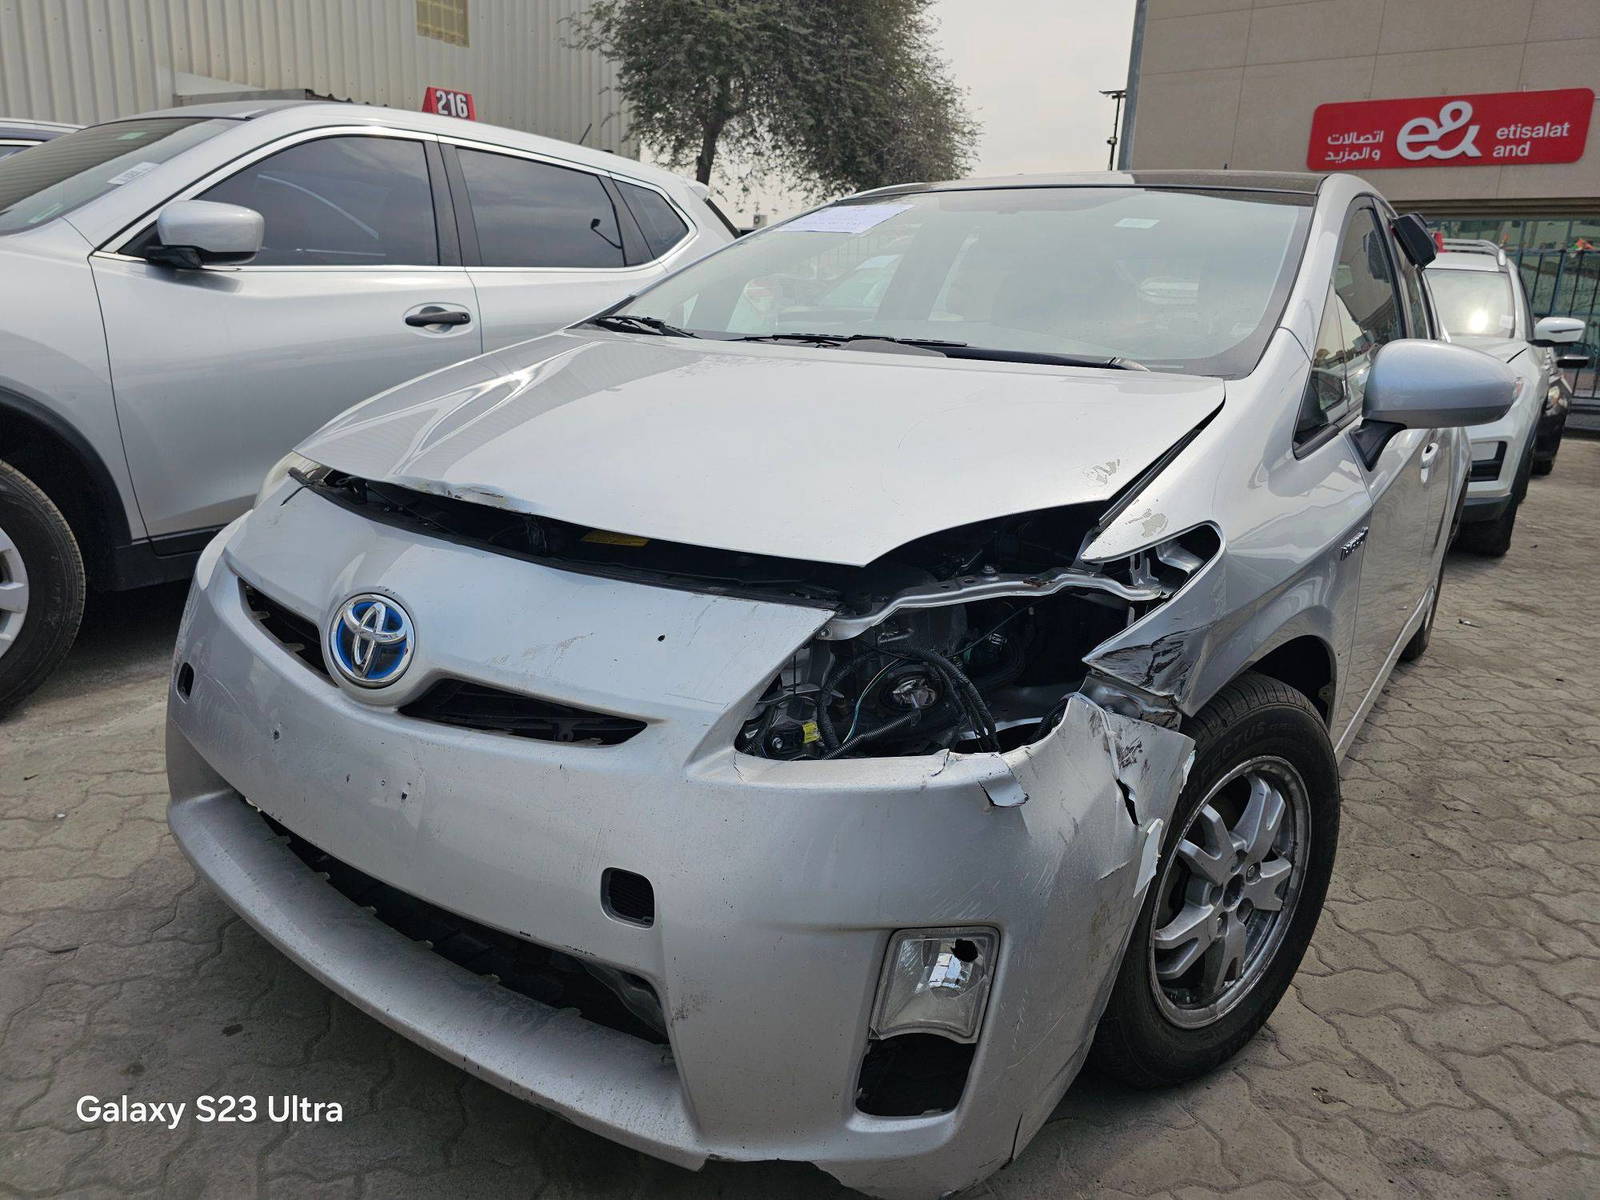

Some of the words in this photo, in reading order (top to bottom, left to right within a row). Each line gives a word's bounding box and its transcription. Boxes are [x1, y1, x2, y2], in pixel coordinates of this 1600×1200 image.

[436, 89, 468, 118] 216
[1327, 130, 1384, 145] اتصالات
[1396, 101, 1482, 161] e&
[1495, 122, 1570, 140] etisalat
[1492, 142, 1530, 158] and
